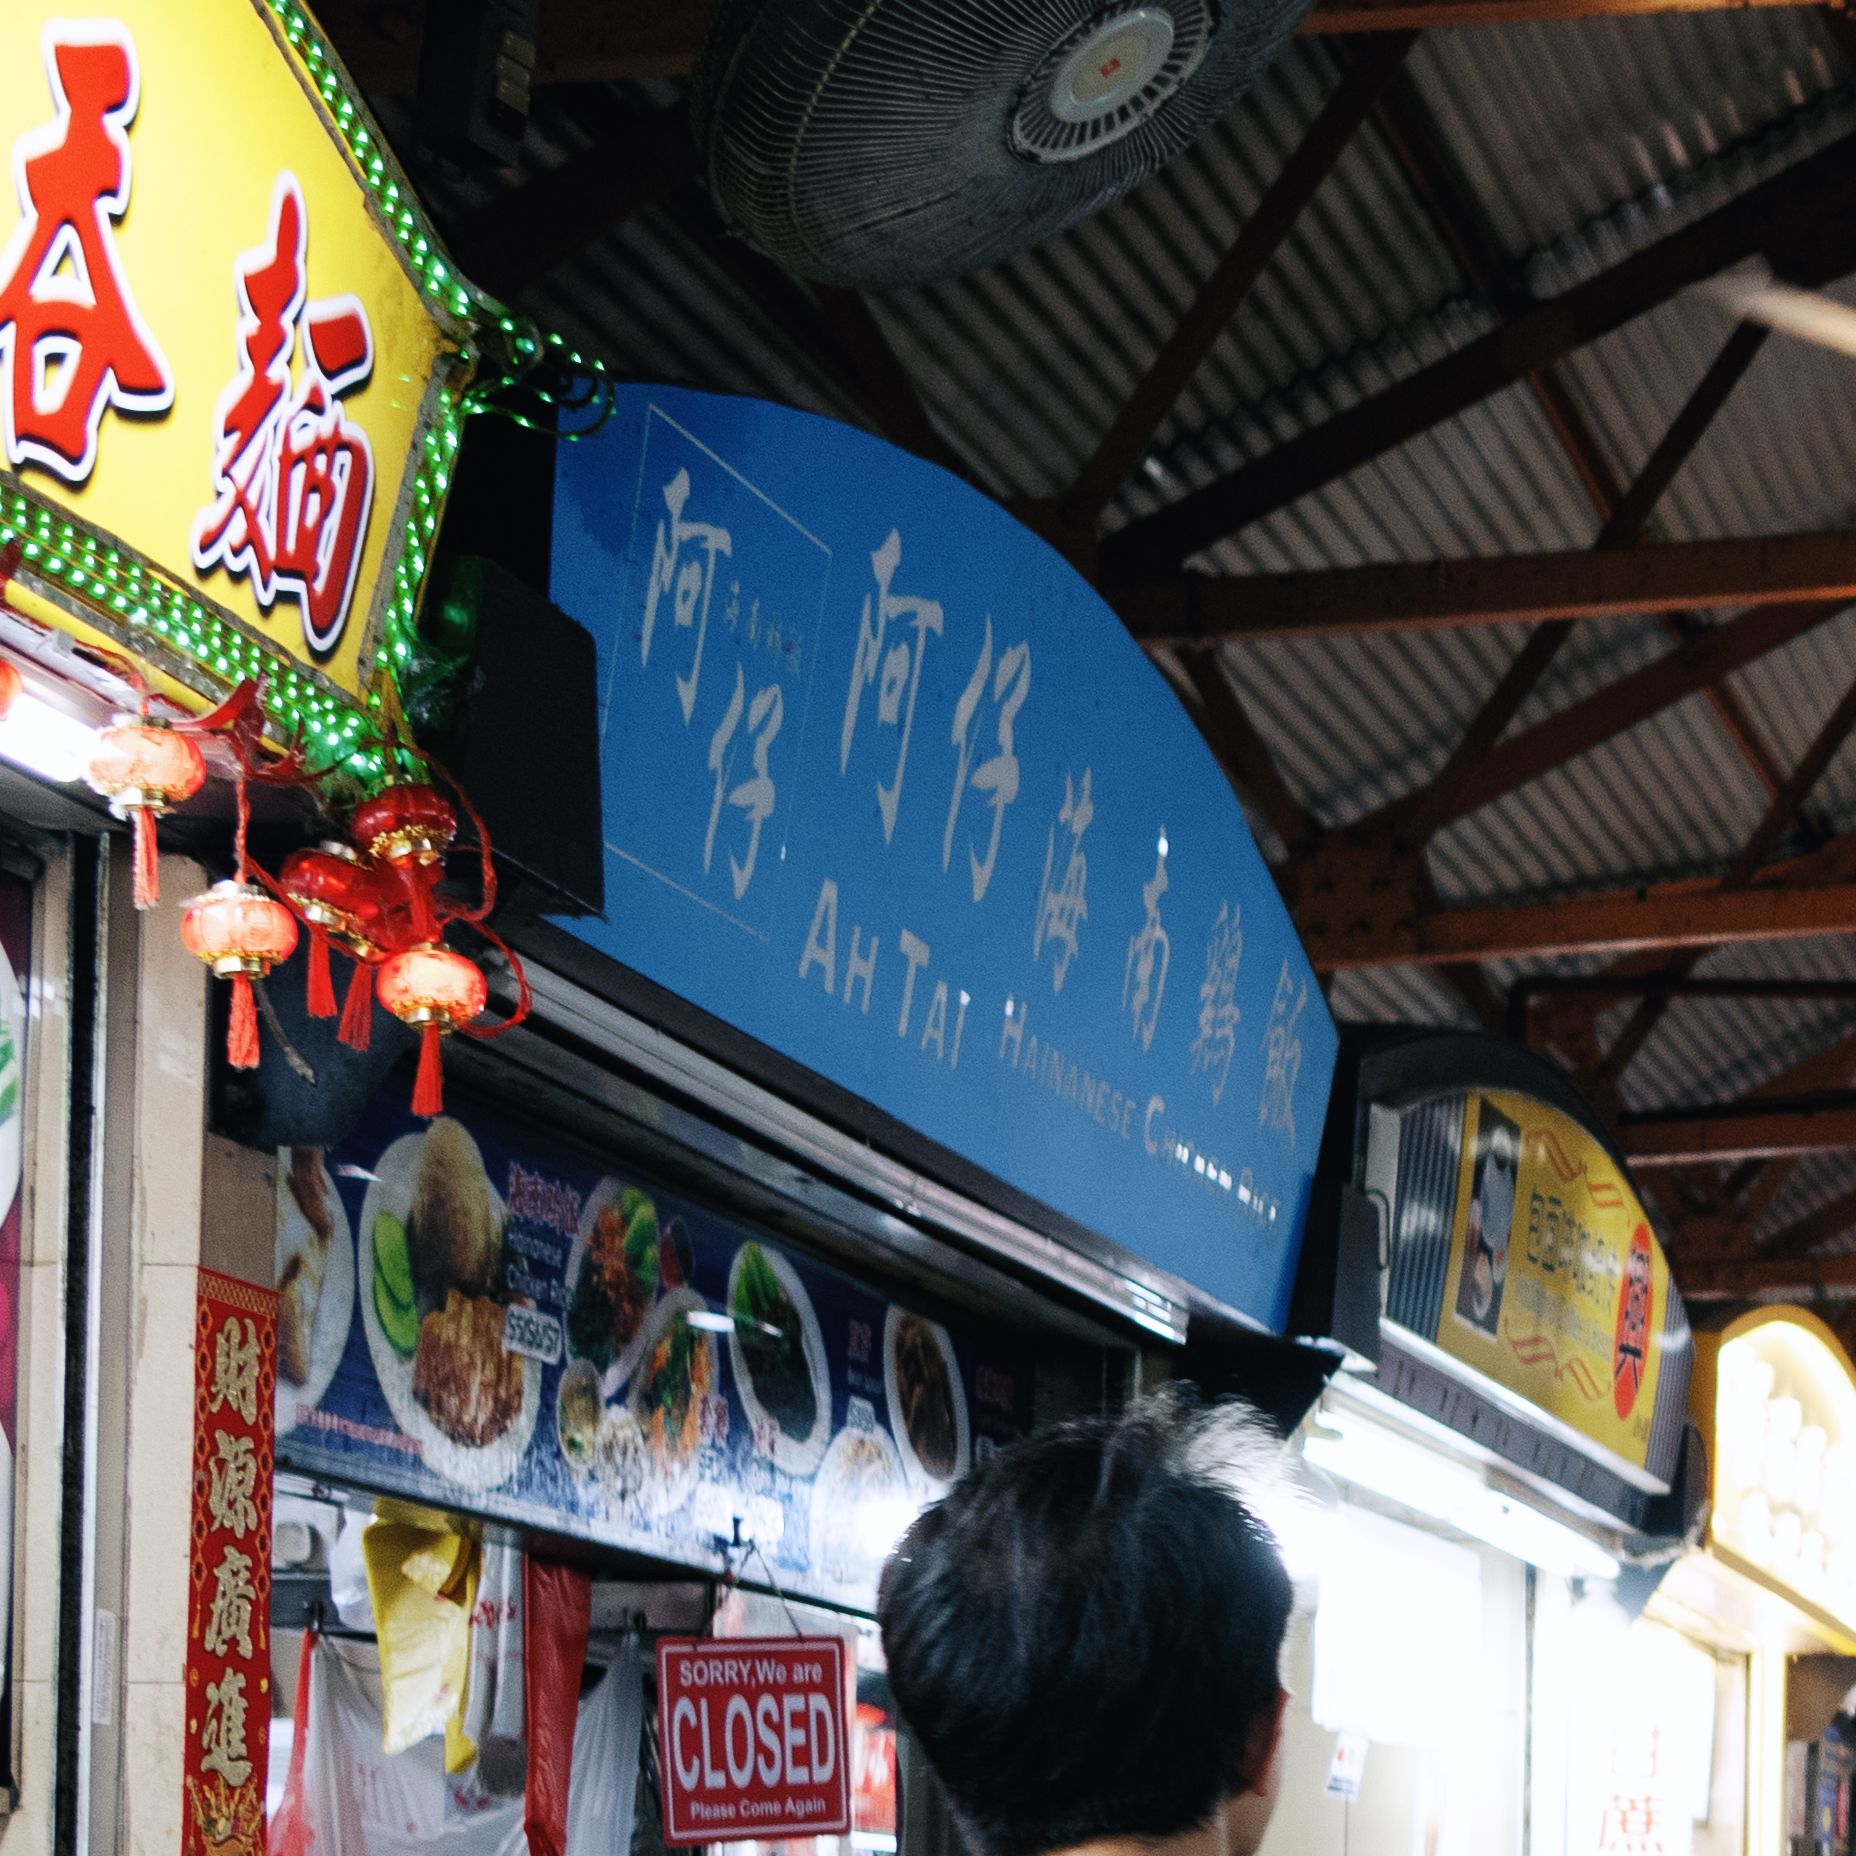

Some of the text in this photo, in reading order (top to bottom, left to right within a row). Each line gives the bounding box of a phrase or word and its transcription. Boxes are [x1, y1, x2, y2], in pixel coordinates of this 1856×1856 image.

[799, 880, 880, 1015] AH
[898, 929, 970, 1069] TAI
[200, 1316, 262, 1787] 財源廣進
[793, 1662, 823, 1684] are
[673, 1692, 835, 1792] CLOSED
[690, 1796, 826, 1821] Please Come Again
